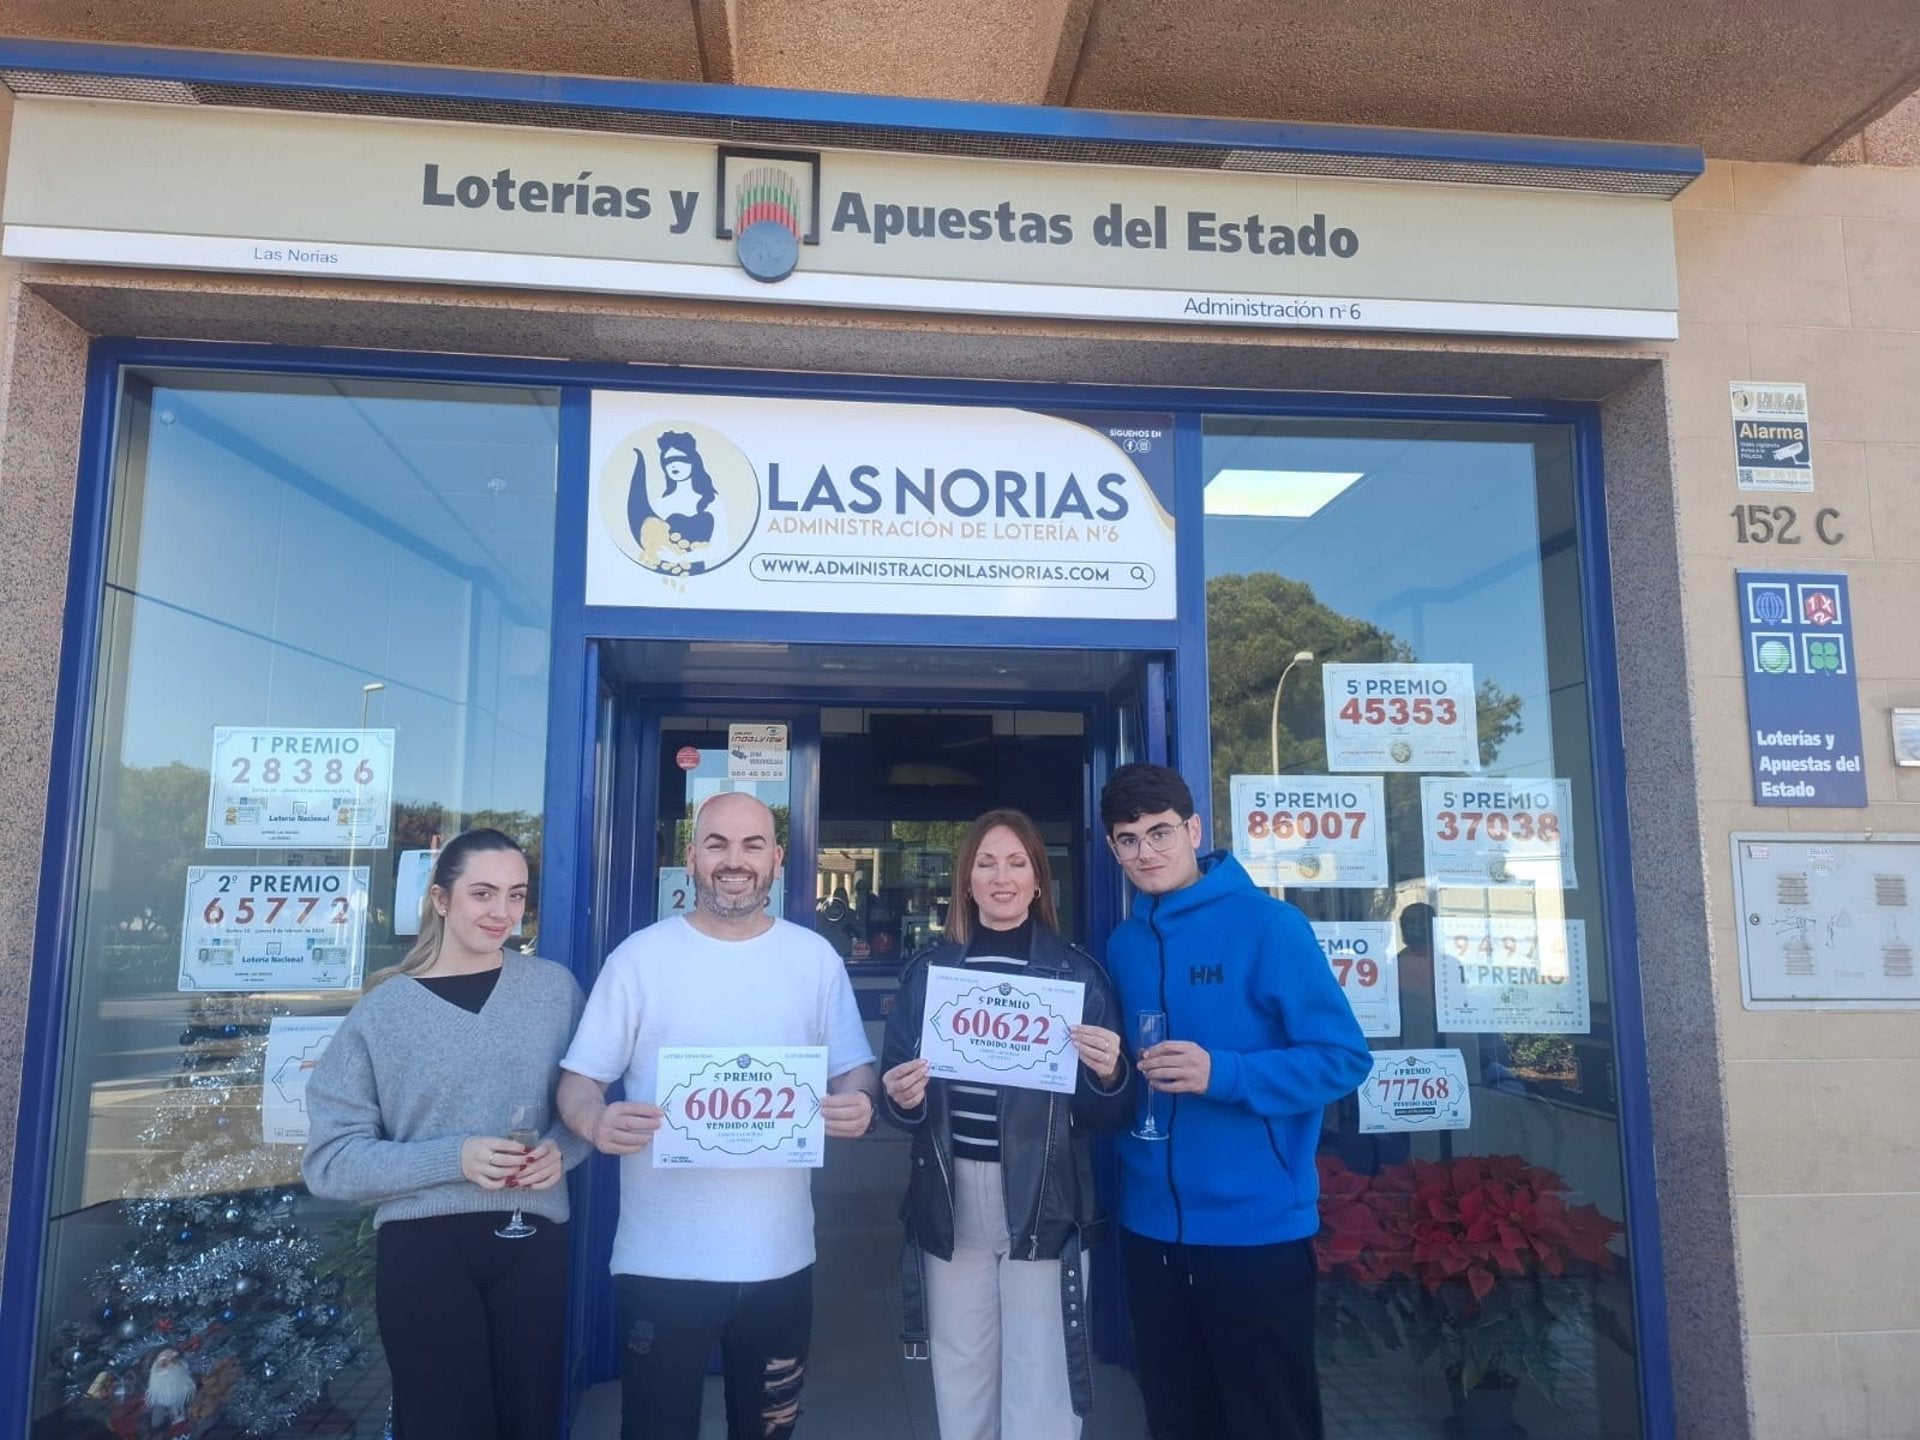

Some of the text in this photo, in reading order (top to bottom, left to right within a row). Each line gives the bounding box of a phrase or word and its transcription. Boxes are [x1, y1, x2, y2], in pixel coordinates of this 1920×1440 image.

[422, 164, 699, 234] Loterías y
[831, 192, 1360, 259] Apuestas del Estado
[254, 246, 338, 264] Las Norias
[1184, 297, 1323, 319] Administración
[1740, 423, 1804, 440] Alarma
[768, 463, 1129, 522] LAS NORIAS
[767, 517, 952, 539] ADMINISTRACIÓN
[961, 522, 987, 540] DE
[994, 521, 1079, 542] LOTERÍA
[1730, 504, 1844, 545] 152 C
[762, 558, 1110, 582] WWW.ADMINISTRACIONLASNORIAS.COM
[1366, 679, 1447, 695] PREMIO
[1340, 698, 1457, 725] 45353
[271, 736, 360, 754] PREMIO
[1757, 730, 1835, 750] Loterías y
[232, 757, 374, 785] 28386
[1759, 755, 1860, 775] Apuestas del
[1761, 781, 1815, 797] Estado
[1275, 792, 1357, 809] PREMIO
[1463, 792, 1550, 809] PREMIO
[1247, 811, 1367, 839] 86007
[1437, 811, 1560, 841] 37038
[250, 875, 340, 893] PREMIO
[203, 897, 349, 925] 65772
[1478, 966, 1564, 985] PREMIO
[986, 997, 1030, 1009] PREMIO
[952, 1007, 1050, 1045] 60622
[970, 1038, 1007, 1048] VENDIDO
[724, 1072, 773, 1082] PREMIO
[1400, 1068, 1431, 1076] PREMIO
[1378, 1077, 1449, 1101] 77768
[684, 1087, 796, 1121] 60622
[706, 1122, 749, 1130] VENDIDO
